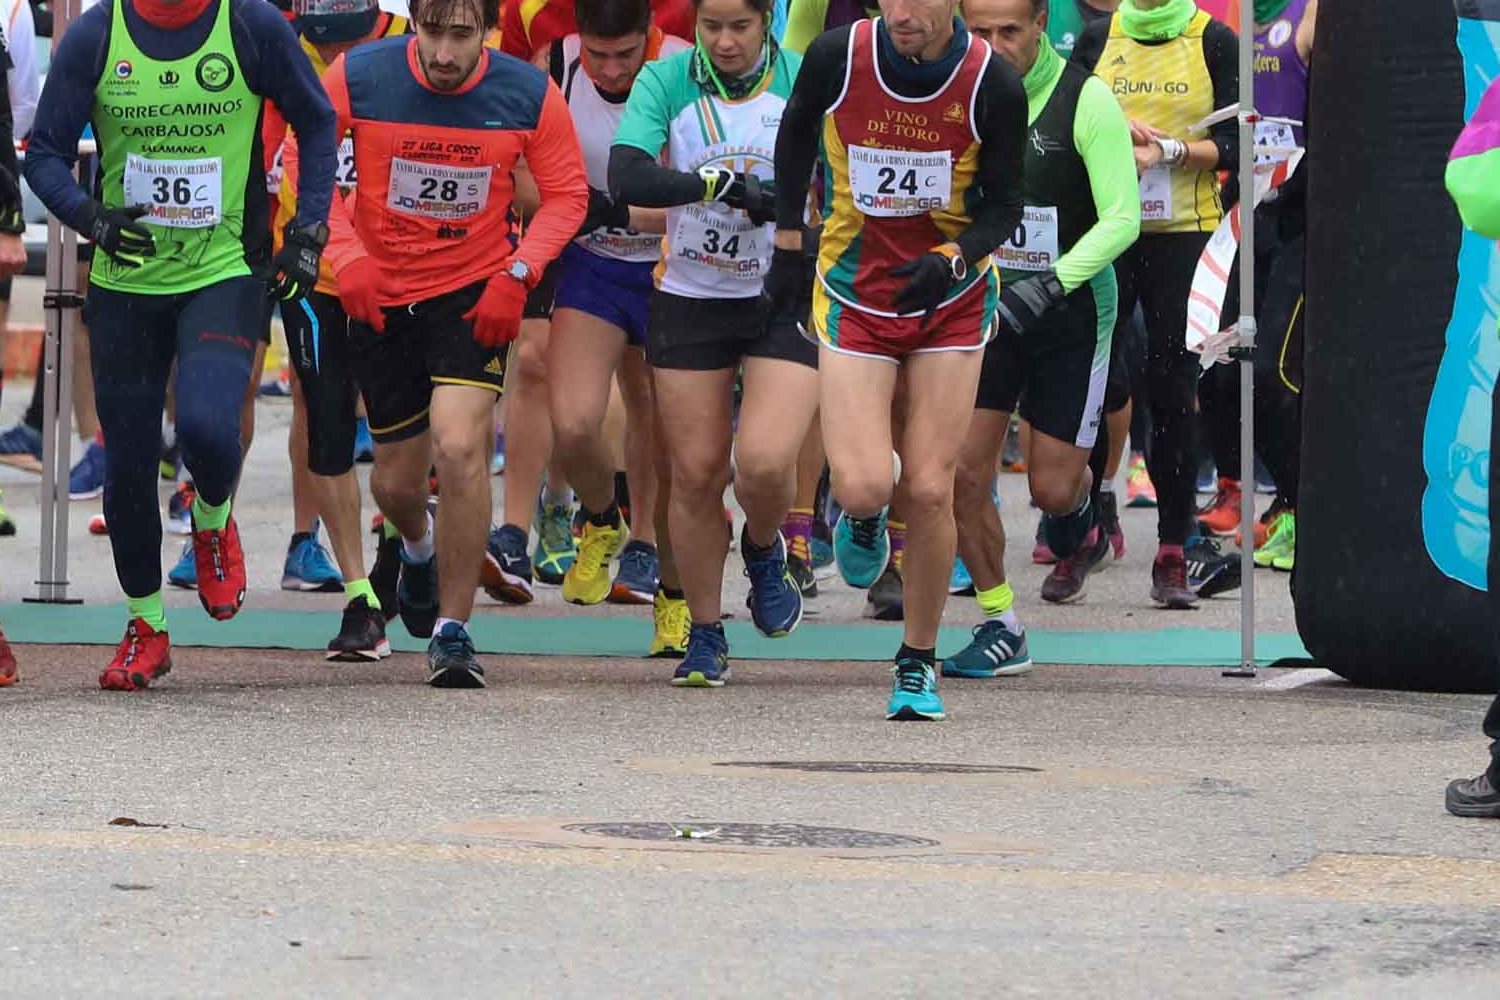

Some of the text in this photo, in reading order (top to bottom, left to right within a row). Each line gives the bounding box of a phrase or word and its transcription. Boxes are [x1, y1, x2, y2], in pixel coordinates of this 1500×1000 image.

[1164, 81, 1189, 94] GO
[102, 98, 243, 119] CORRECAMINOS
[884, 109, 928, 126] VINO
[121, 123, 226, 138] CARBAJOSA
[867, 119, 940, 143] DE TORO
[141, 144, 207, 154] SALAMANCA
[419, 141, 443, 153] LIGA
[445, 143, 482, 156] CROSS
[418, 178, 459, 202] 28
[877, 167, 918, 196] 24
[152, 177, 191, 205] 36
[393, 195, 480, 213] JOMISAGA
[856, 192, 942, 210] JOMISAGA
[147, 205, 216, 219] MISAGA
[702, 228, 741, 259] 34
[677, 247, 760, 272] JOMISAGA
